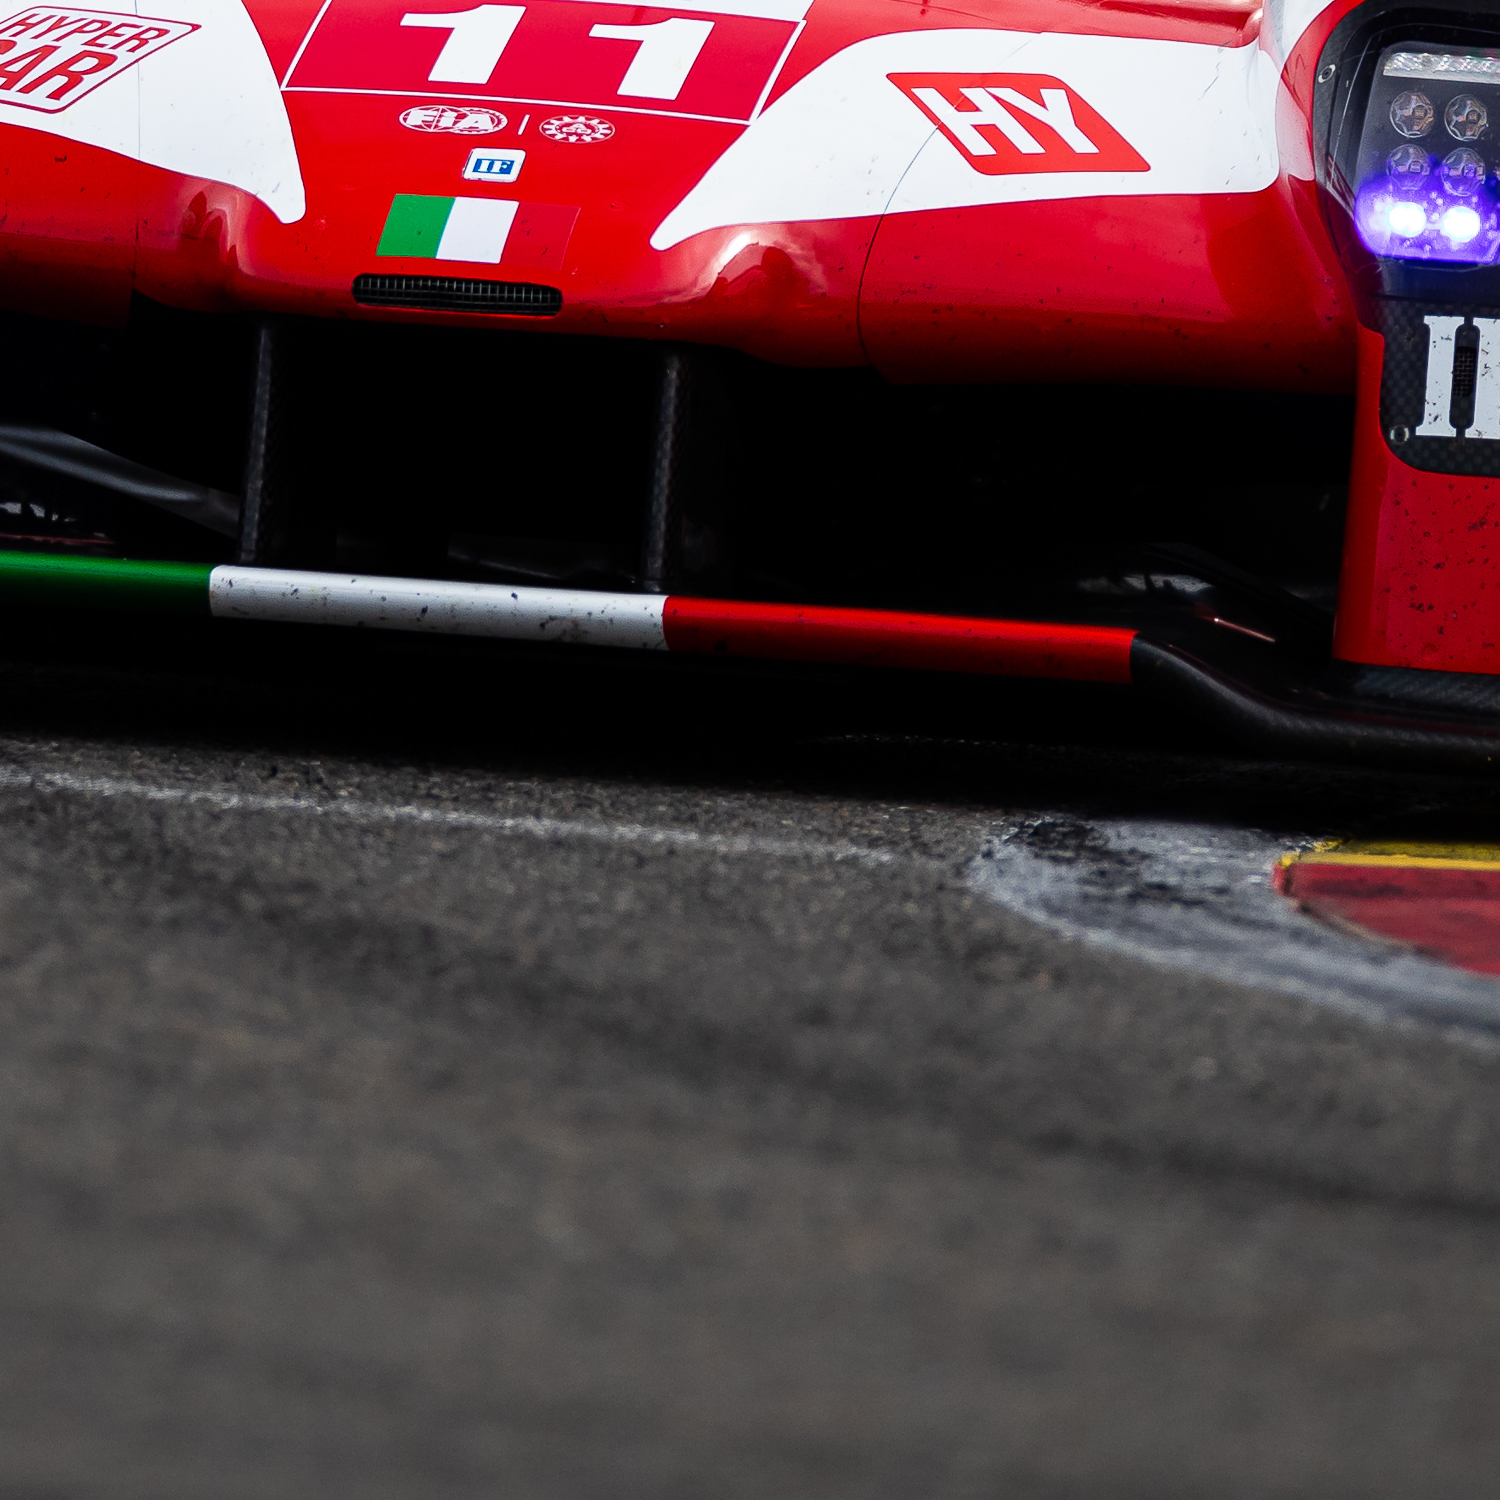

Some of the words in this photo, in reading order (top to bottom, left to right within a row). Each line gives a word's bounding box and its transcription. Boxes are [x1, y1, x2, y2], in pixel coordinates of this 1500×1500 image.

[400, 4, 716, 99] 11
[910, 88, 1100, 155] HY
[476, 159, 513, 175] IF
